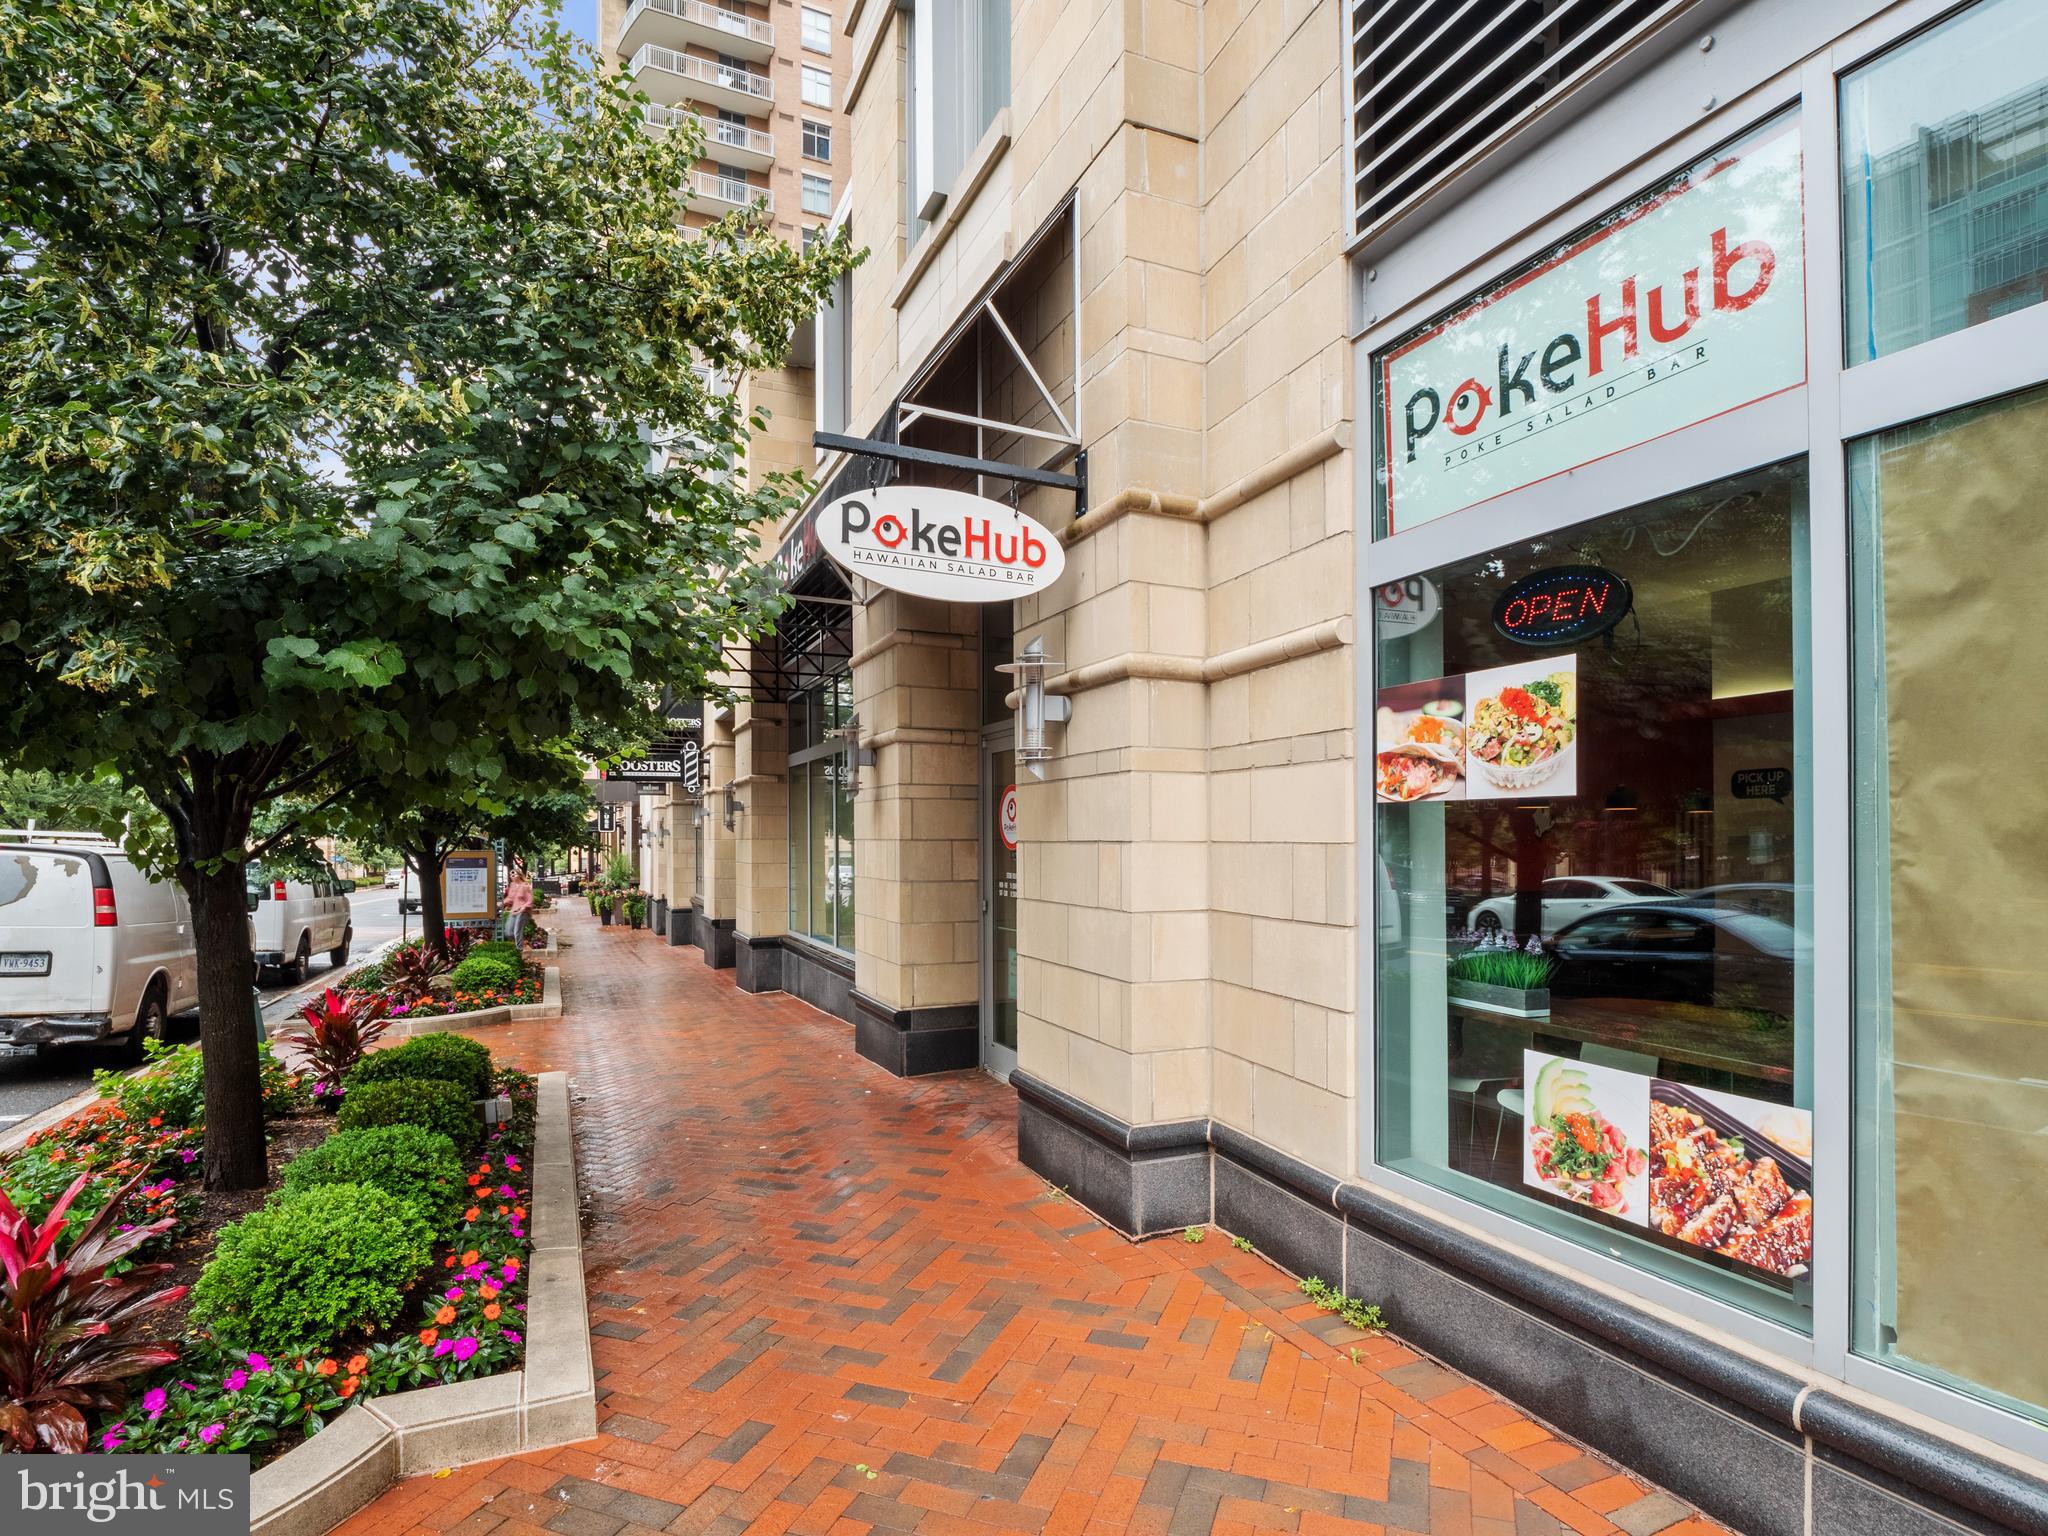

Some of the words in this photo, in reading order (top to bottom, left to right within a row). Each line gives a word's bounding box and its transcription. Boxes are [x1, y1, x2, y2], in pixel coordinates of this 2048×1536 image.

[1445, 435, 1502, 467] POKE
[1527, 386, 1616, 432] SALAD
[1646, 346, 1706, 381] BAR
[853, 550, 938, 570] HAWAIIAN
[947, 562, 997, 578] SALAD
[1006, 570, 1035, 583] BAR
[1503, 582, 1610, 629] OPEN
[609, 760, 681, 772] OOSTERS
[1737, 772, 1764, 784] PICK
[1767, 770, 1785, 782] UP
[1746, 784, 1776, 796] HERE
